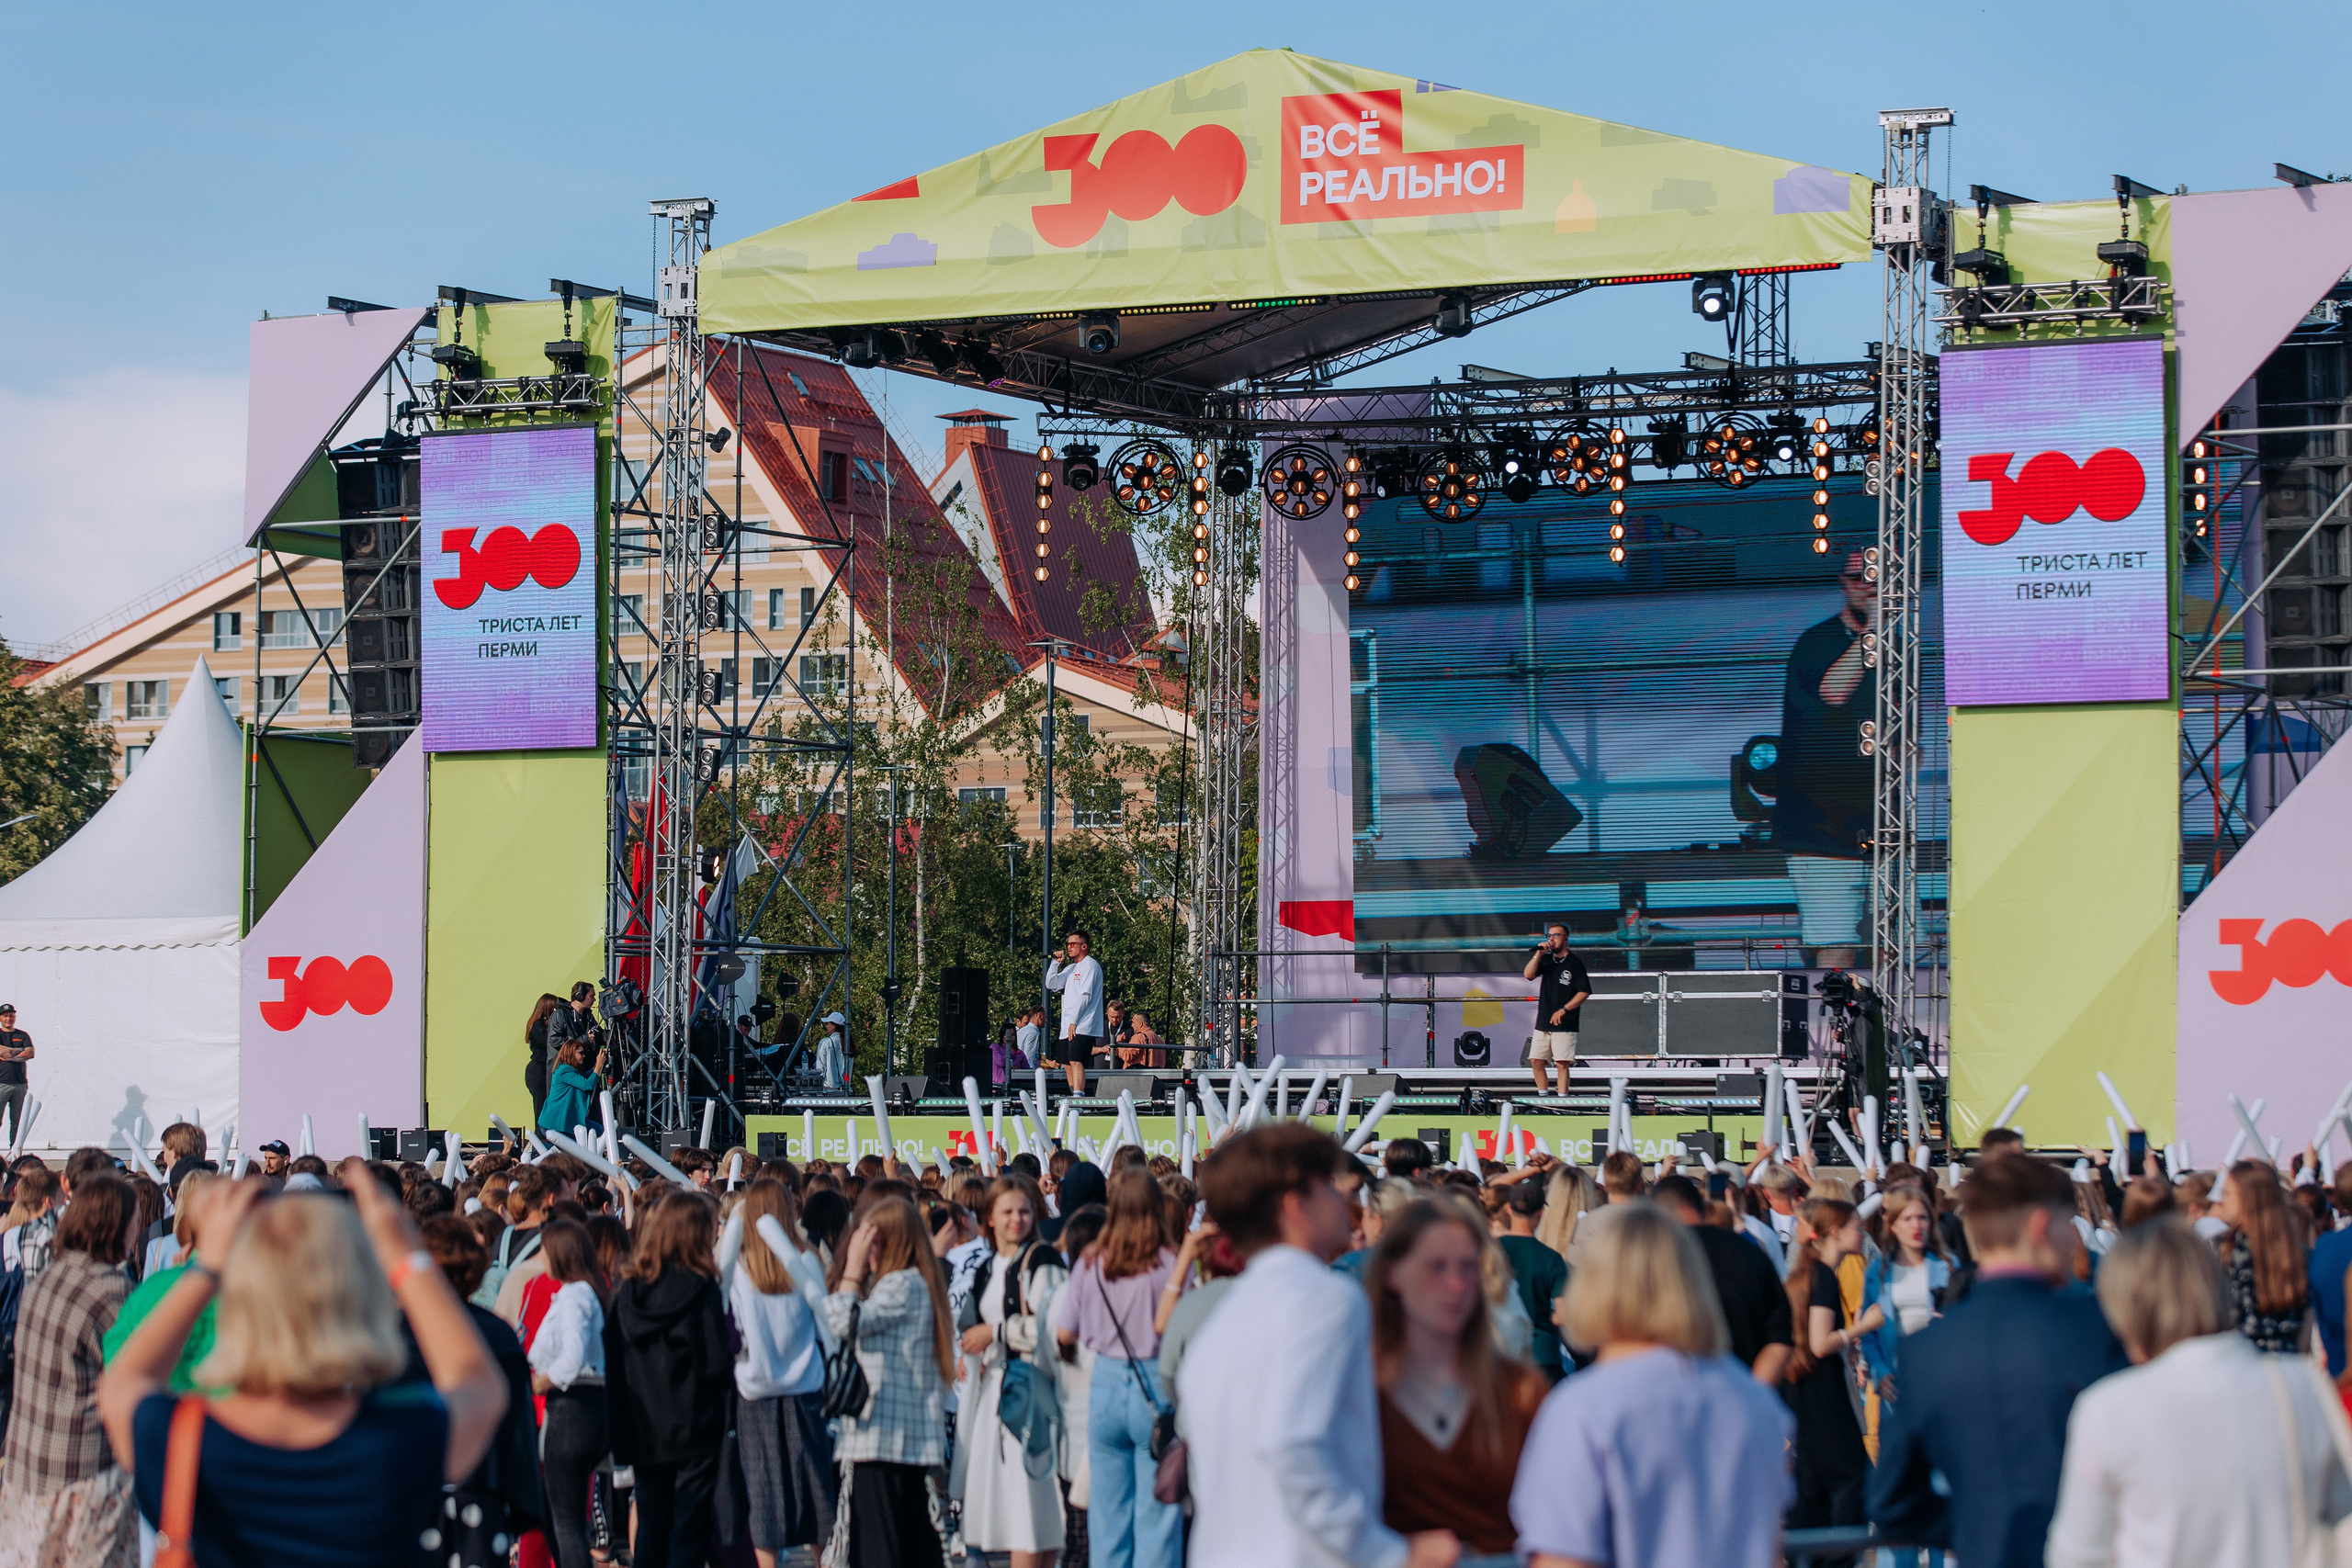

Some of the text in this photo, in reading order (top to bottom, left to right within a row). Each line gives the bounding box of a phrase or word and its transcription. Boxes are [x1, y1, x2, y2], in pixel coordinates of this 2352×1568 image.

[1300, 110, 1380, 159] ВСЁ
[1031, 124, 1247, 248] 300
[1299, 159, 1505, 206] РЕАЛЬНО!
[1957, 447, 2145, 546] 300
[433, 523, 581, 610] 300
[2017, 551, 2147, 572] ТРИСТА ЛЕТ
[2017, 581, 2091, 600] ПЕРМИ
[479, 615, 582, 634] ТРИСТА ЛЕТ
[478, 641, 537, 658] ПЕРМИ
[259, 954, 393, 1032] 300
